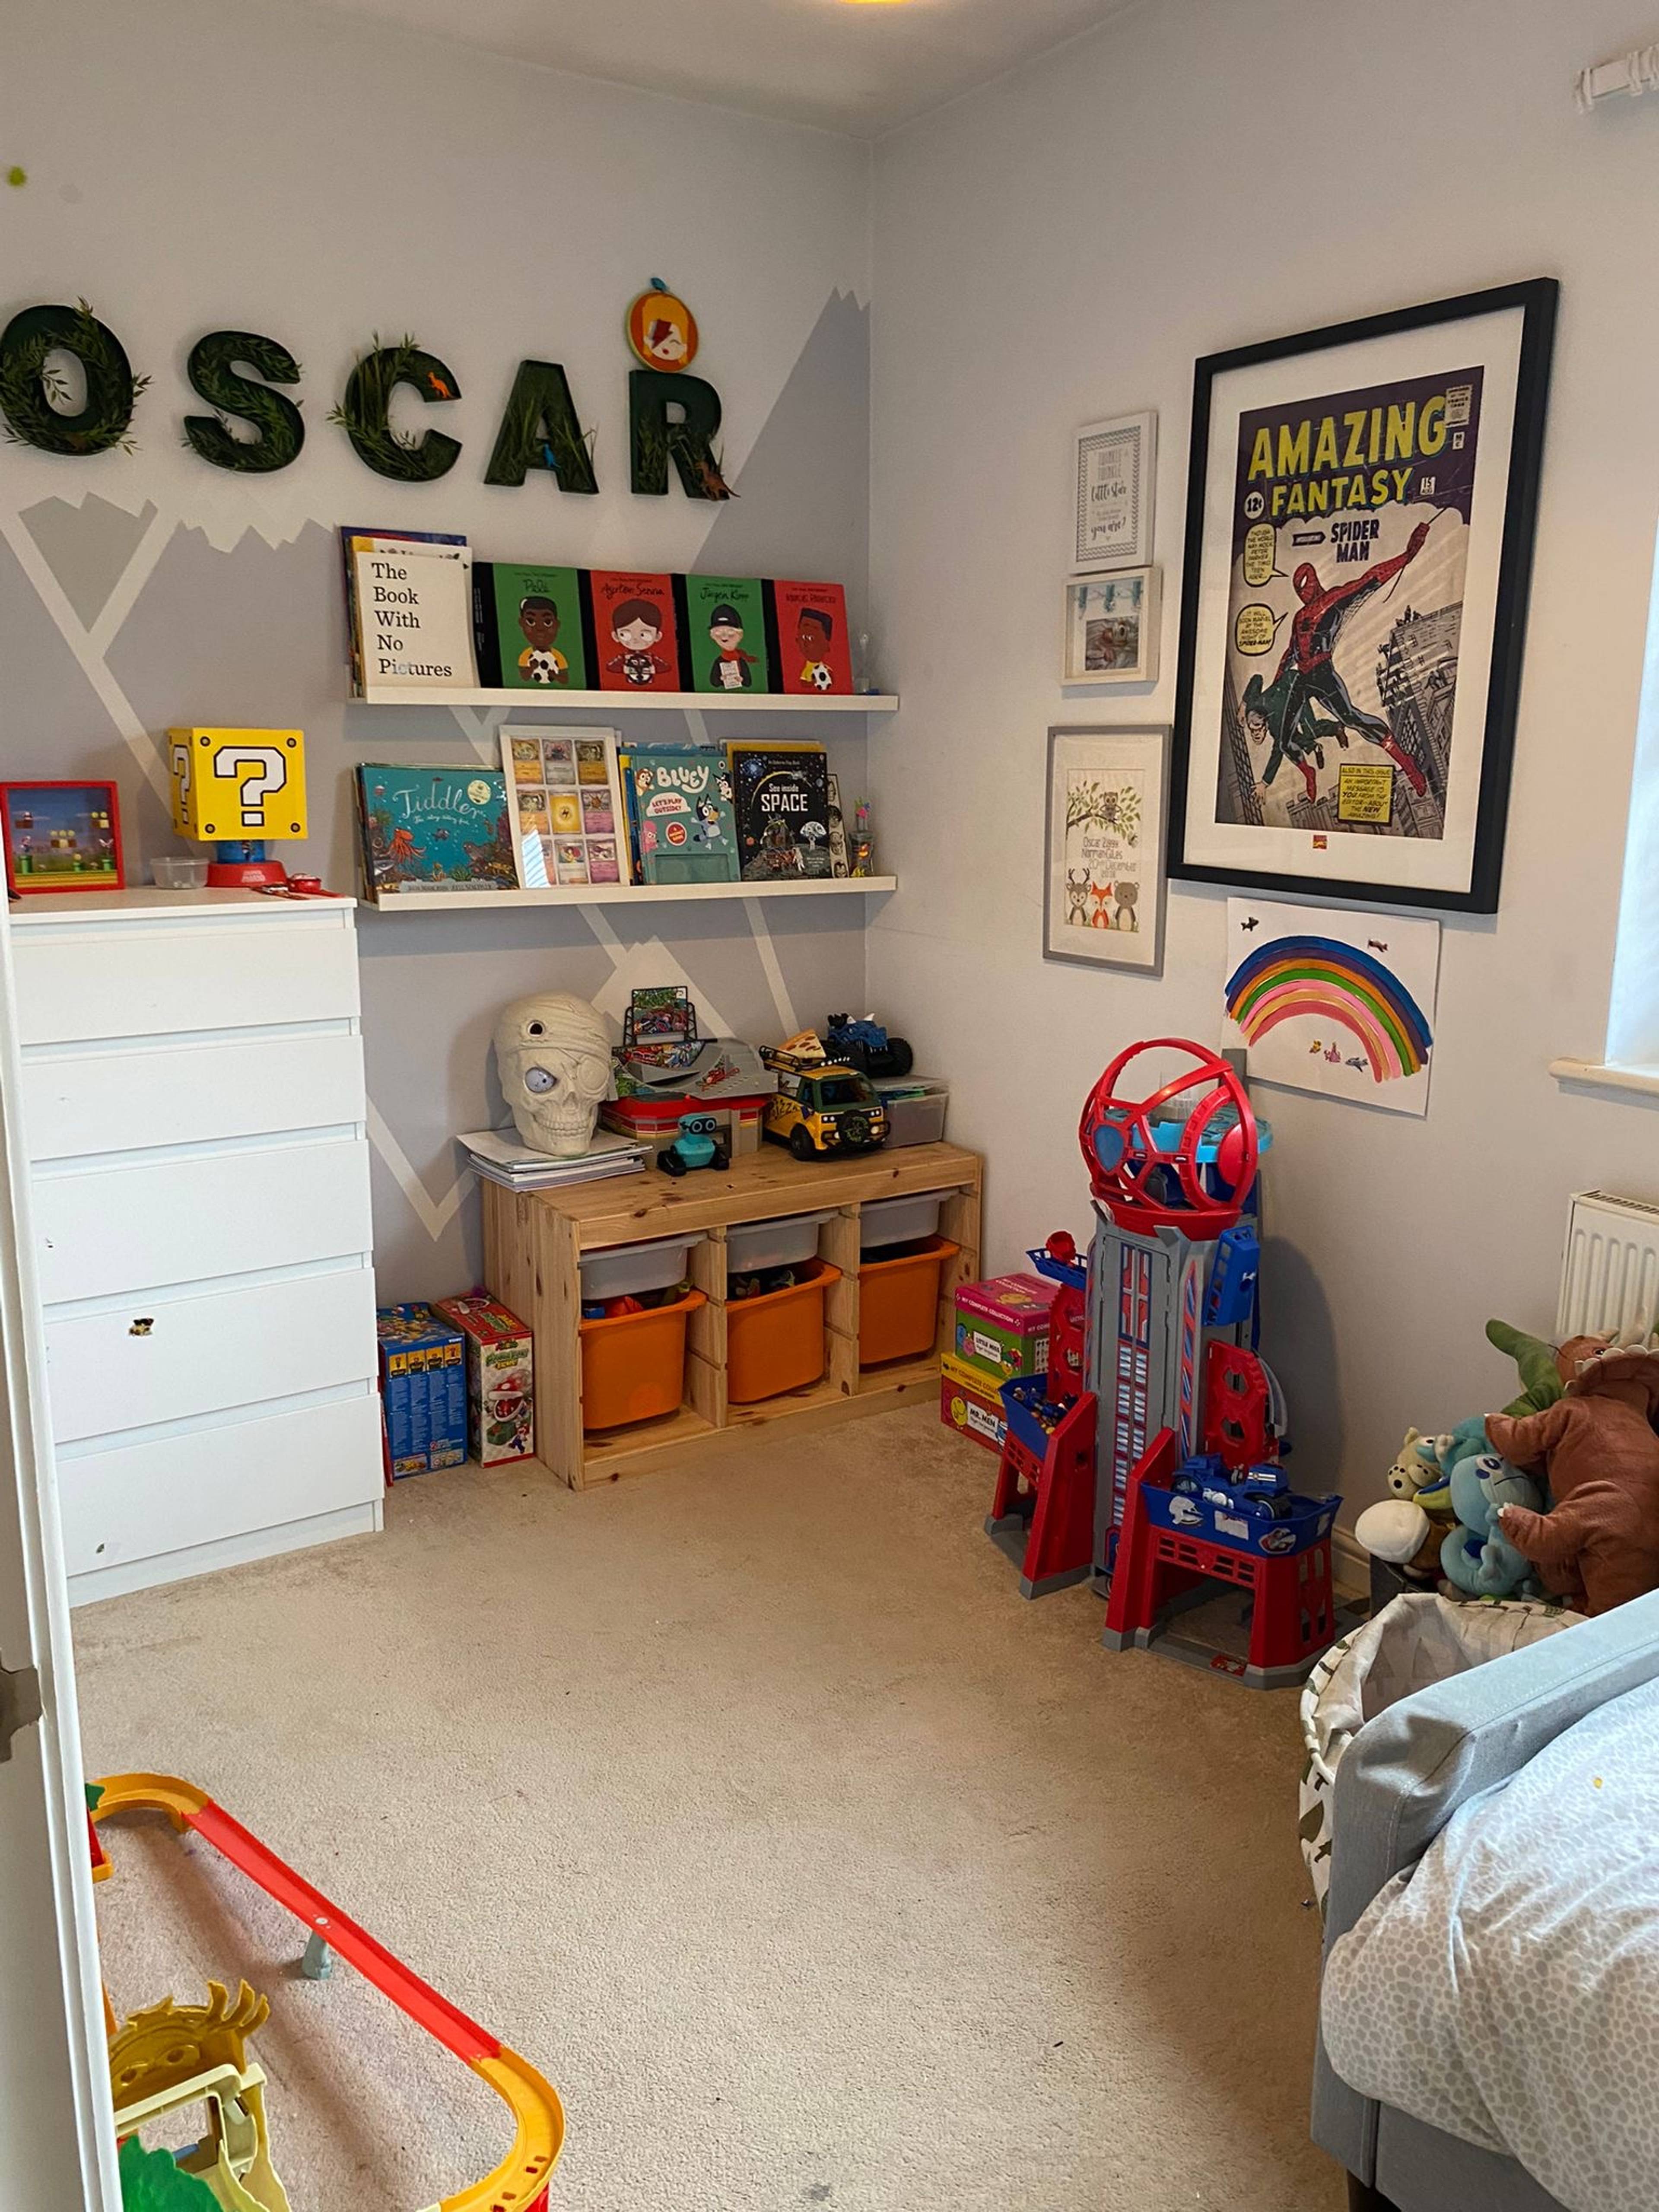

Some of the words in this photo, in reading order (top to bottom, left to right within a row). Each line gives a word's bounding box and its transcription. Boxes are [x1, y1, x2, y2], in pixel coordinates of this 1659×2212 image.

[0, 305, 730, 500] OSCAR
[1247, 395, 1448, 482] AMAZING
[1272, 467, 1414, 517] FANTASY
[1330, 519, 1379, 543] SPIDER
[1337, 541, 1370, 563] MAN
[372, 563, 407, 580] The
[373, 586, 419, 605] Book
[375, 610, 421, 628] With
[377, 634, 404, 651] No
[378, 658, 452, 677] Pictures
[657, 765, 709, 794] BLUEY
[392, 782, 477, 819] Tiddler
[761, 794, 808, 812] SPACE
[975, 1337, 988, 1347] LITTLE
[989, 1343, 1000, 1353] MISS
[970, 1408, 981, 1420] MR.
[982, 1414, 995, 1427] MEN
